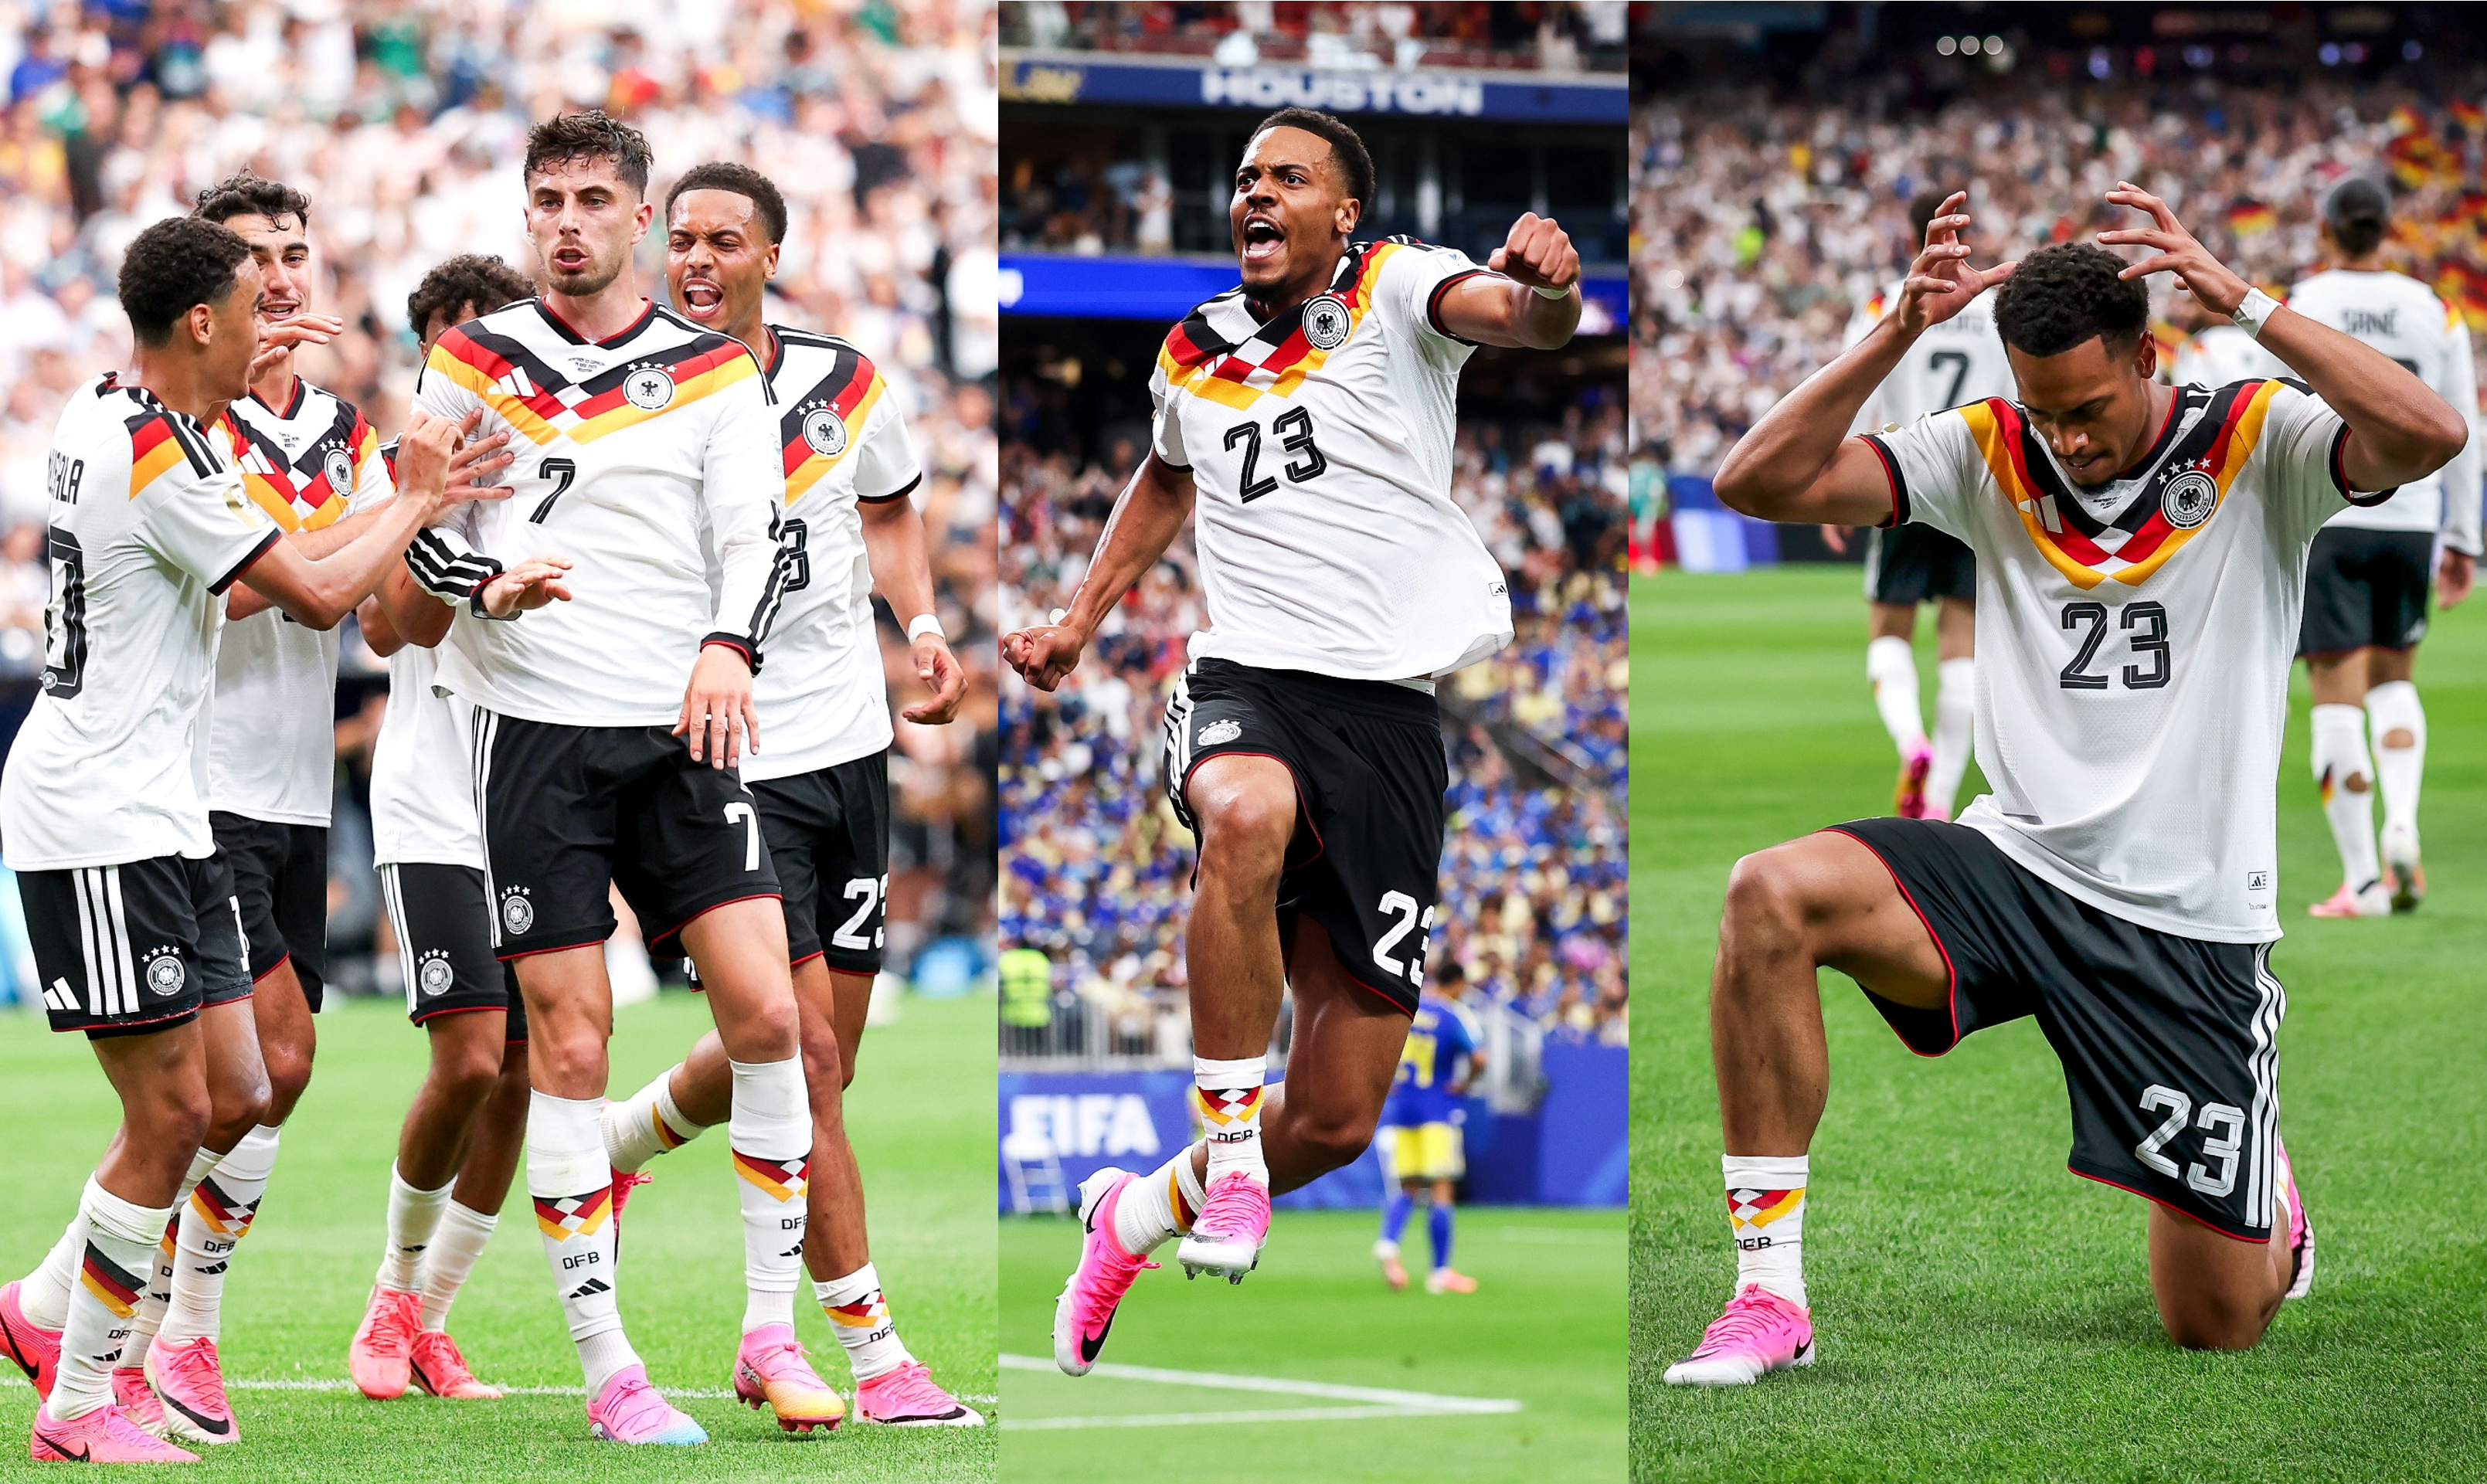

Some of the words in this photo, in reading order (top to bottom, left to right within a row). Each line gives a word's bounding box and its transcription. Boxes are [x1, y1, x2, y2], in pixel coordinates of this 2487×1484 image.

[1200, 70, 1483, 114] HOUSTON
[1223, 405, 1328, 504] 23
[2172, 479, 2202, 495] DEUTSCHER
[529, 457, 576, 525] 7
[2060, 600, 2171, 689] 23
[723, 802, 759, 871] 7
[1009, 1093, 1162, 1158] FIFA
[2134, 1084, 2245, 1198] 23
[562, 1251, 600, 1270] DFB
